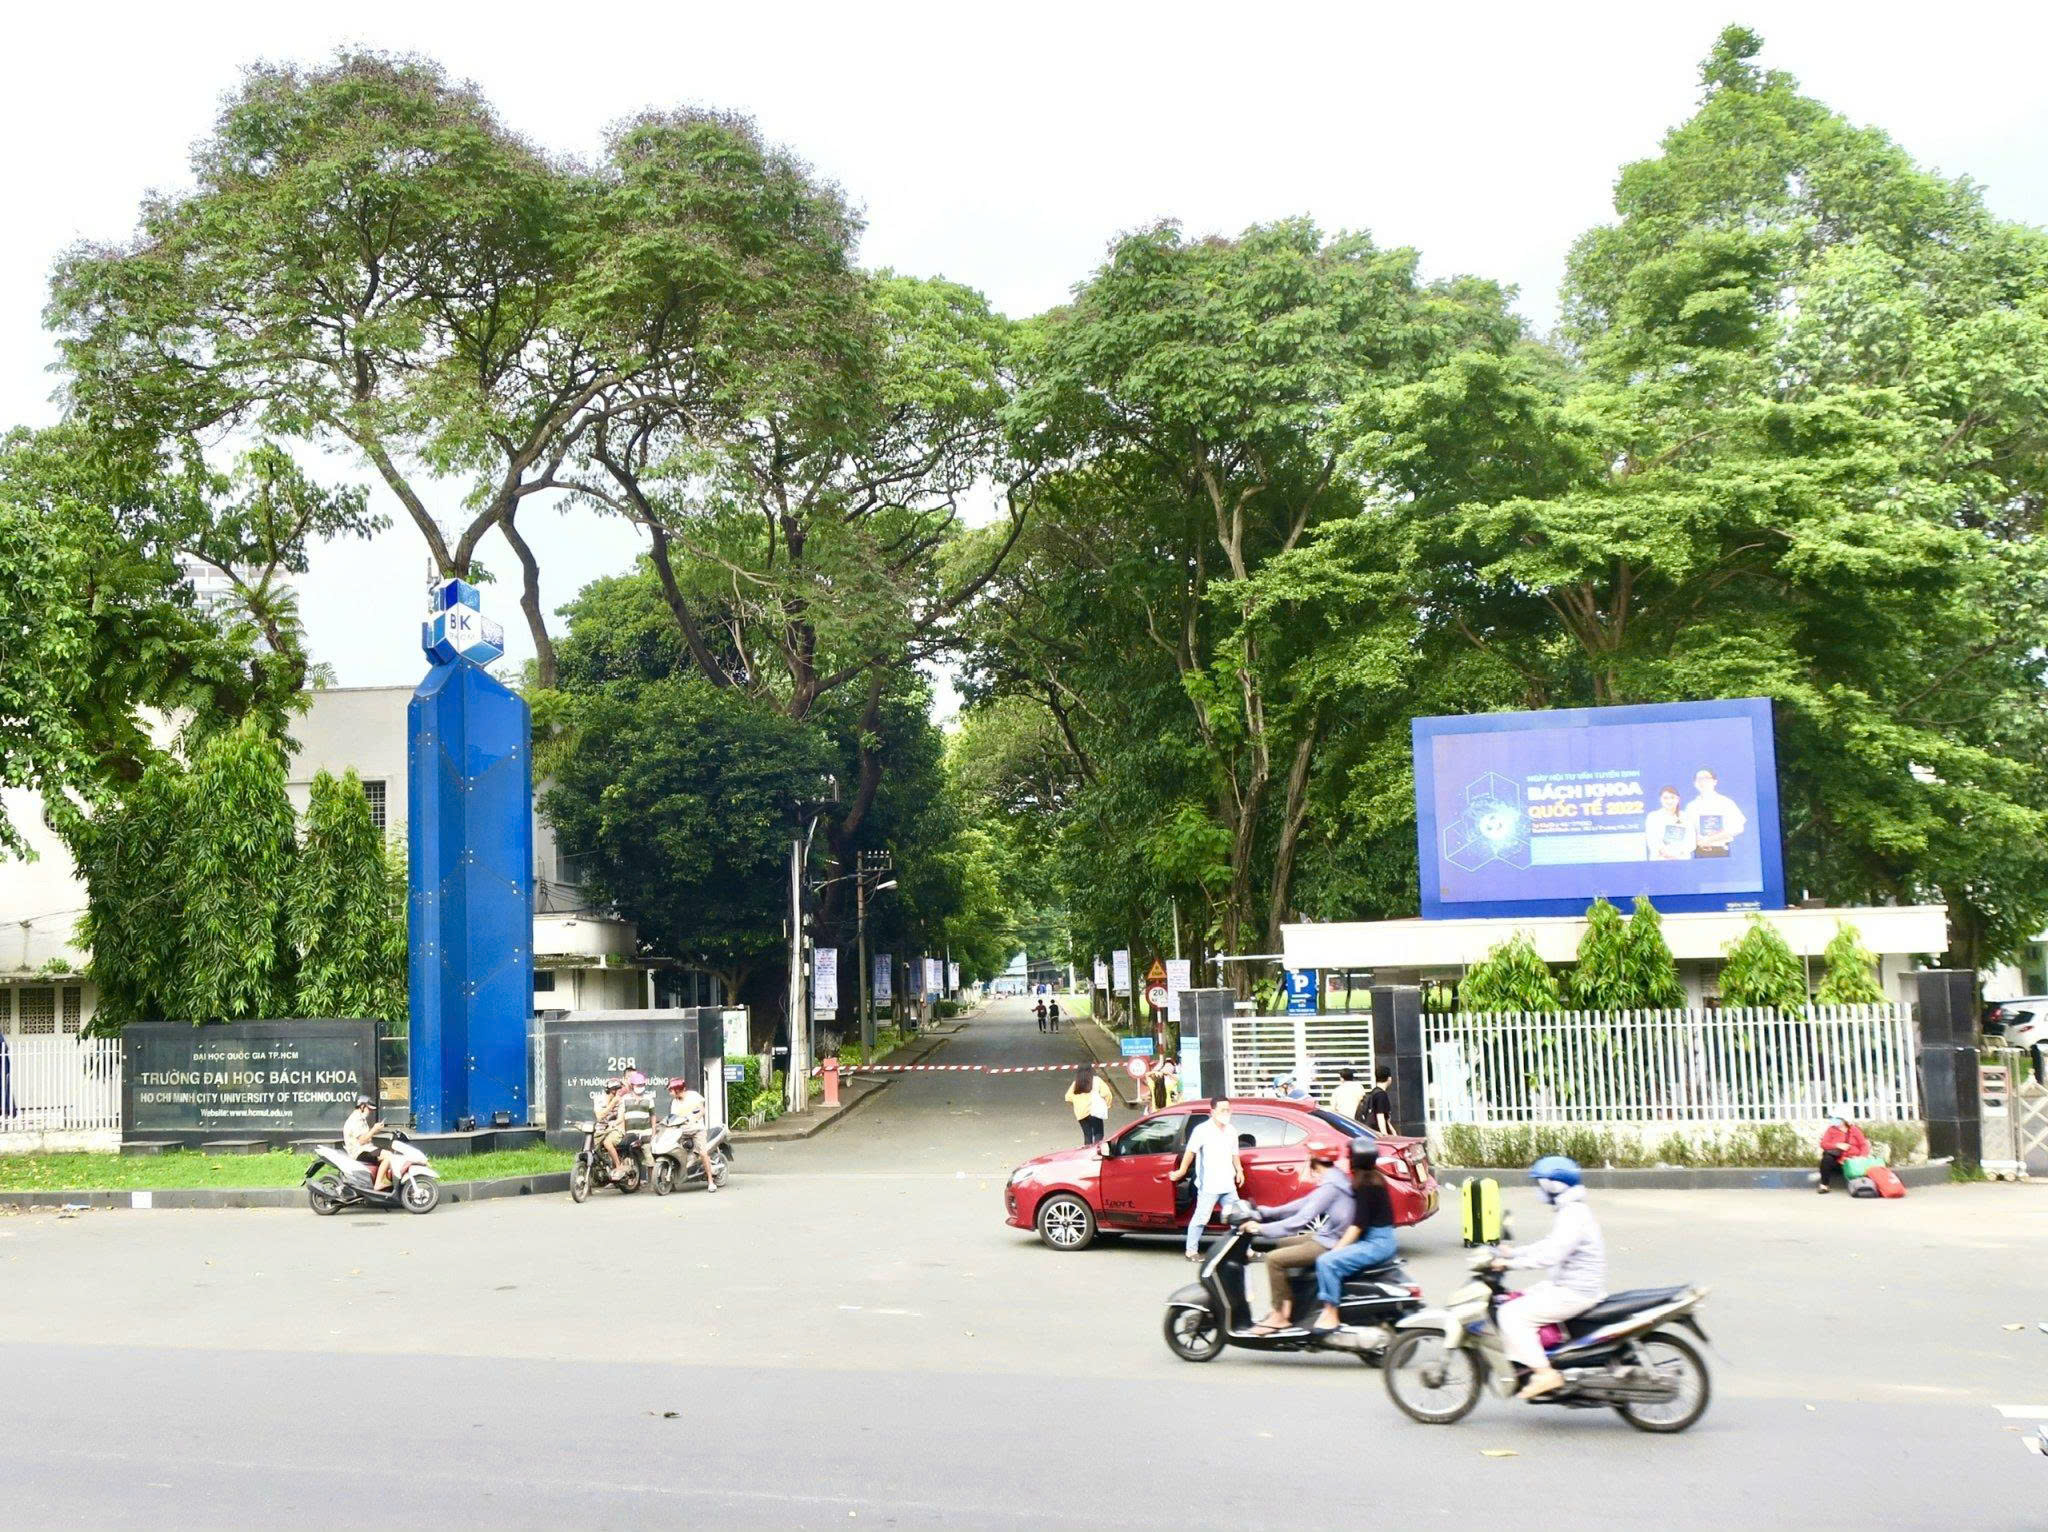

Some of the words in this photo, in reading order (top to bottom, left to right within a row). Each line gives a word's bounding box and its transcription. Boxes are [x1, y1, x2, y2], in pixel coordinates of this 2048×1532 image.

[450, 613, 471, 630] BK
[1527, 783, 1582, 801] BÁCH
[1584, 781, 1643, 797] KHOA
[1528, 799, 1578, 818] QUỐC
[1580, 798, 1603, 816] TẾ
[1606, 801, 1644, 815] 2022
[1293, 974, 1309, 993] P
[193, 1053, 206, 1062] ĐẠI
[208, 1053, 225, 1062] HỌC
[227, 1051, 250, 1060] QUỐC
[252, 1052, 266, 1060] GIA
[607, 1056, 636, 1071] 268
[141, 1068, 200, 1085] TRƯỜNG
[203, 1072, 229, 1088] ĐẠI
[233, 1071, 265, 1088] HỌC
[269, 1067, 312, 1084] BÁCH
[316, 1070, 358, 1084] KHOA
[567, 1076, 577, 1086] LÝ
[140, 1092, 154, 1103] HO
[156, 1092, 172, 1103] CHI
[173, 1092, 196, 1103] MINH
[196, 1092, 218, 1103] CITY
[220, 1092, 275, 1103] UNIVERSITY
[277, 1092, 290, 1102] OF
[292, 1091, 358, 1102] TECHNOLOGY
